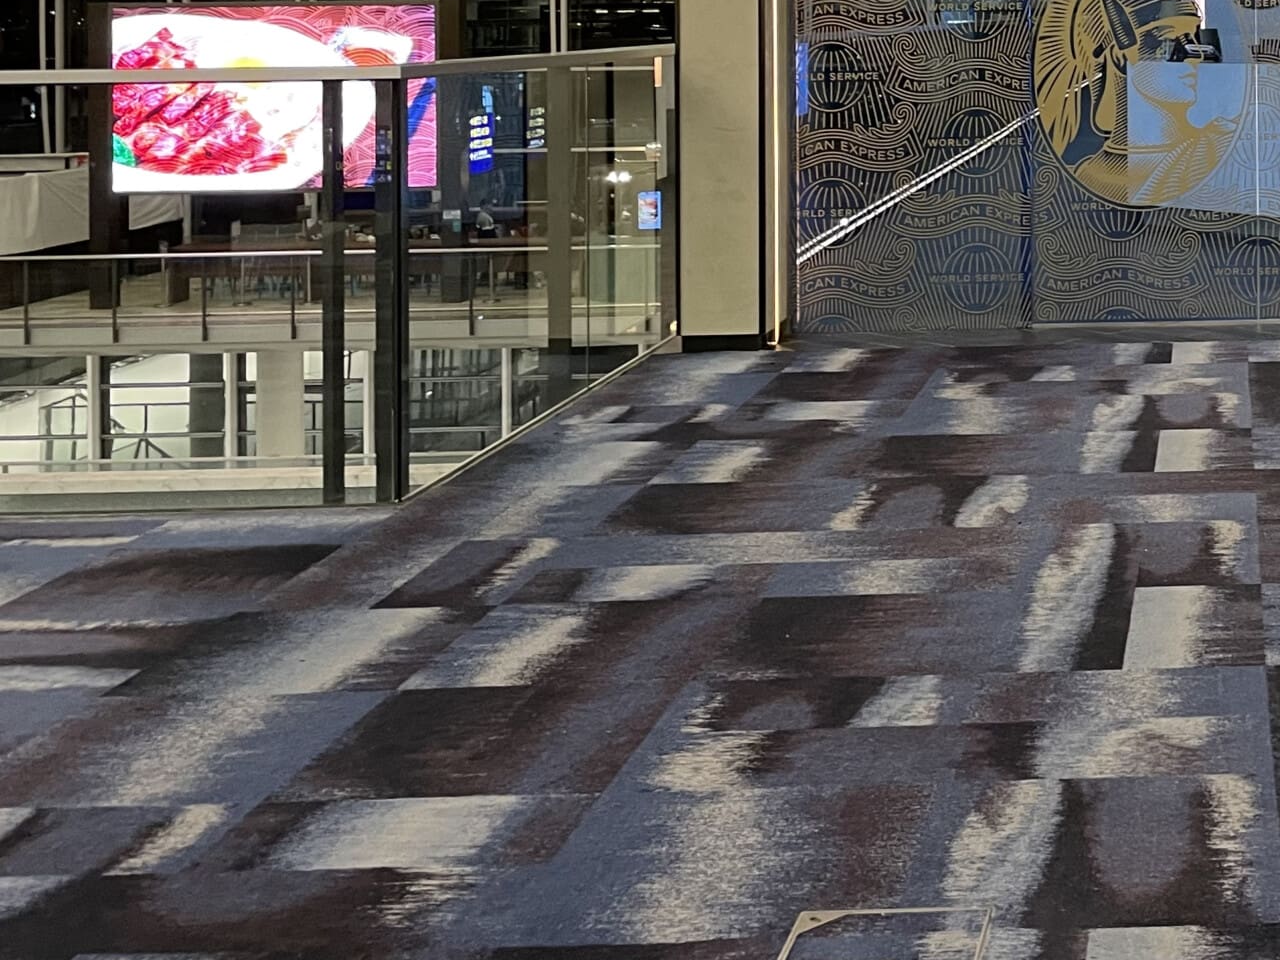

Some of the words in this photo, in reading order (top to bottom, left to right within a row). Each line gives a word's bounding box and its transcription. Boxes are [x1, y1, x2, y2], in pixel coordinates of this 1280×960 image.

[973, 1, 1024, 11] SERVICE
[840, 4, 905, 25] EXPRESS
[829, 71, 880, 81] SERVICE
[902, 69, 980, 93] AMERICAN
[985, 70, 1030, 91] EXPRE
[928, 138, 970, 147] WORLD
[801, 140, 835, 158] ICAN
[840, 142, 905, 161] EXPRESS
[1071, 201, 1112, 212] WORLD
[802, 209, 825, 219] RLD
[903, 205, 981, 228] AMERICAN
[1214, 266, 1253, 277] WORLD
[929, 273, 970, 283] WORLD
[974, 272, 1025, 283] SERVICE
[1046, 269, 1122, 291] AMERICAN
[1126, 269, 1192, 289] EXPRESS
[801, 276, 836, 295] ICAN
[840, 278, 905, 298] EXPRESS
